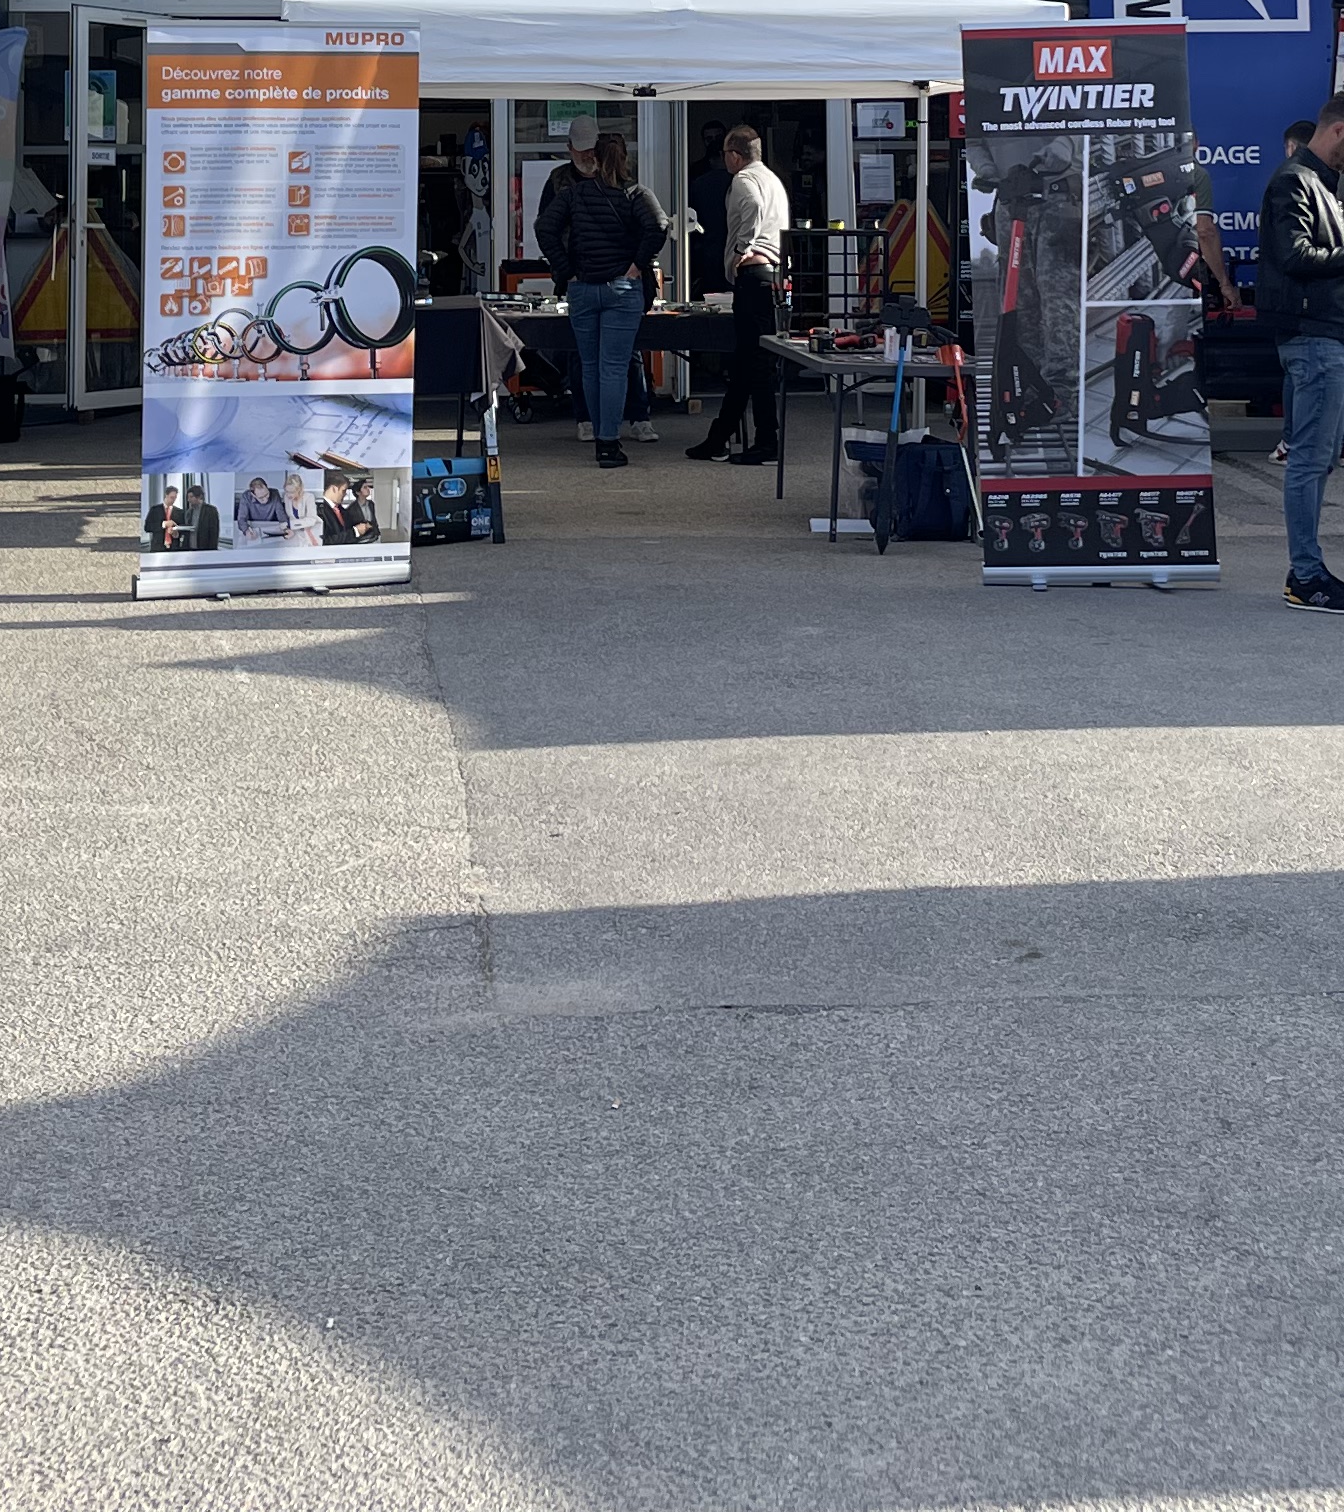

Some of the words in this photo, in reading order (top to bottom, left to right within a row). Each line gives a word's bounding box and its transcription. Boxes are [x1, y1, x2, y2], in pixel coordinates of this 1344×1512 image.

[1038, 46, 1107, 74] MAX
[162, 66, 239, 80] Découvrez
[244, 68, 282, 80] notre
[161, 89, 220, 102] gamme
[225, 86, 297, 102] complète
[302, 86, 321, 99] de
[326, 86, 389, 102] produits
[999, 83, 1155, 121] TWINTIER
[982, 122, 998, 131] The
